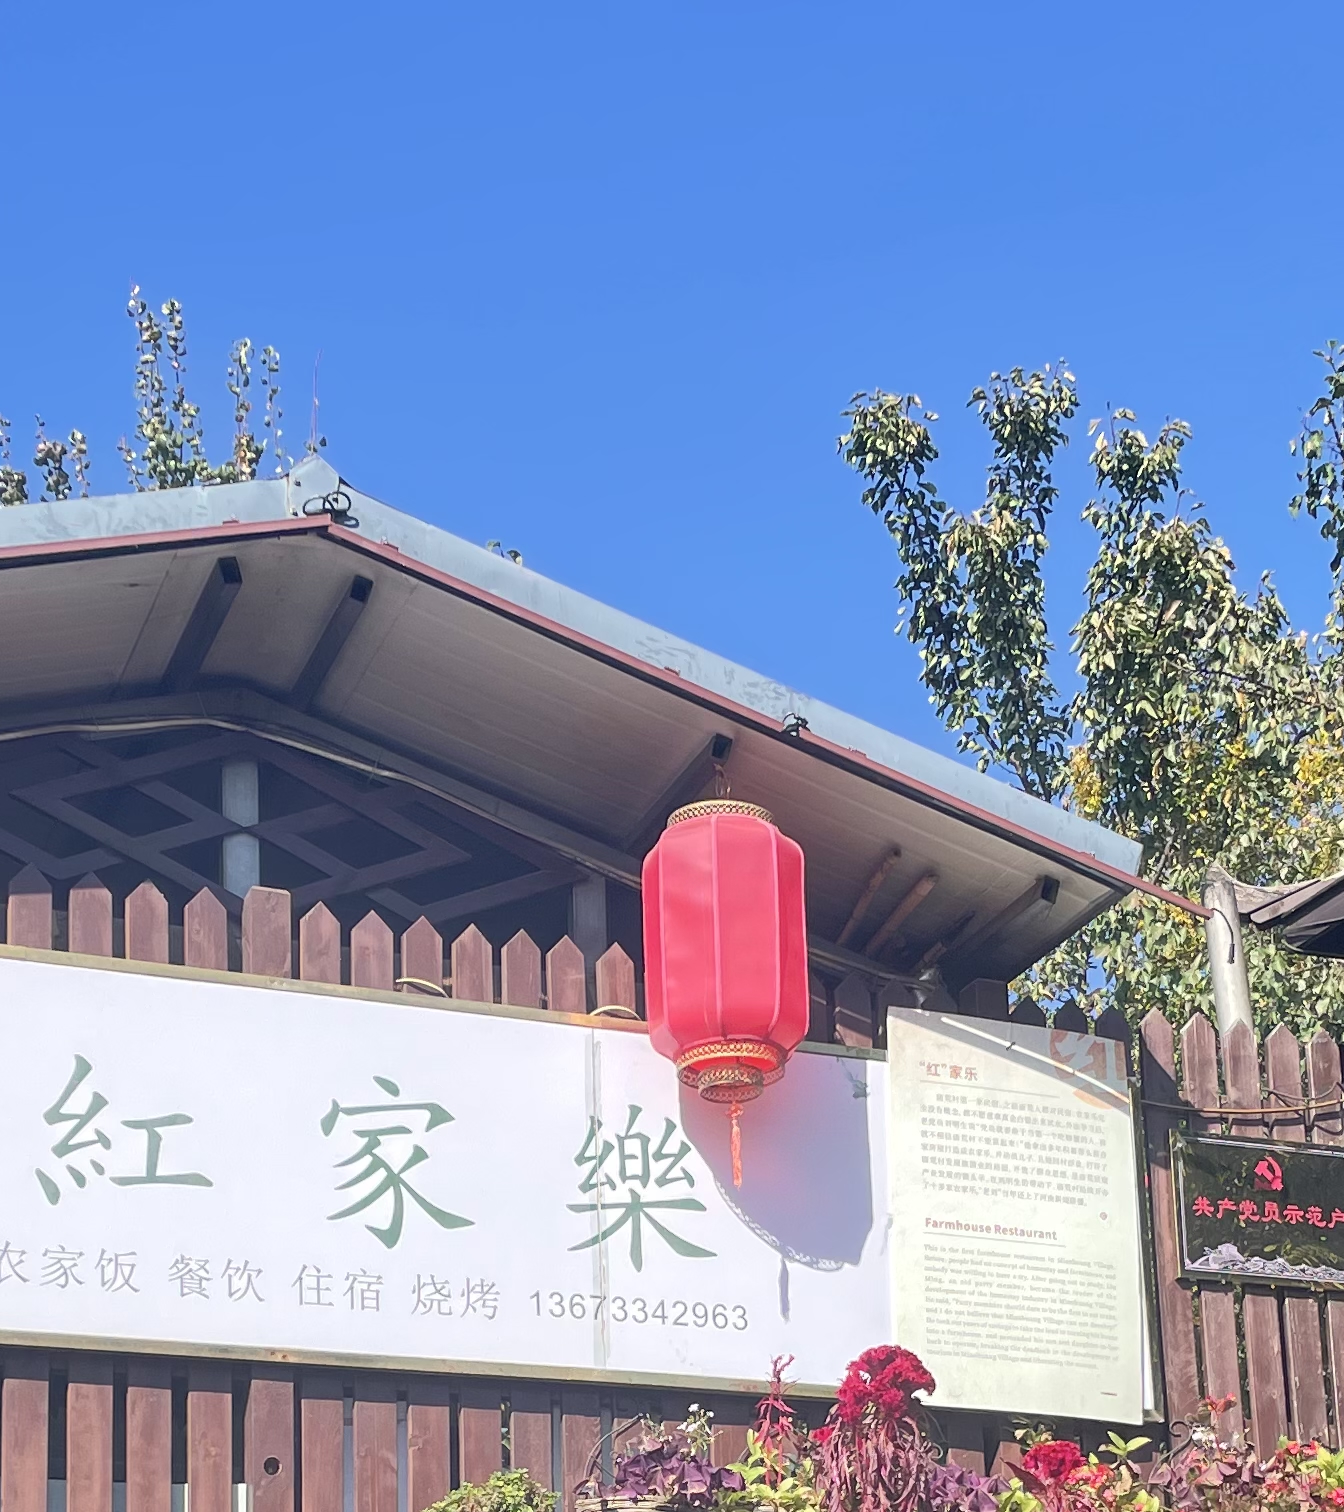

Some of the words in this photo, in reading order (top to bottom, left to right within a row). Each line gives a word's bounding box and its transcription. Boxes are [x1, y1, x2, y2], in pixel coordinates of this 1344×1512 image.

[924, 1217, 992, 1236] Farmhouse
[993, 1223, 1057, 1241] Restaurant
[169, 1256, 266, 1303] 餐饮
[291, 1265, 385, 1313] 住宿
[411, 1276, 502, 1322] 烧烤
[530, 1290, 749, 1332] 13673342963
